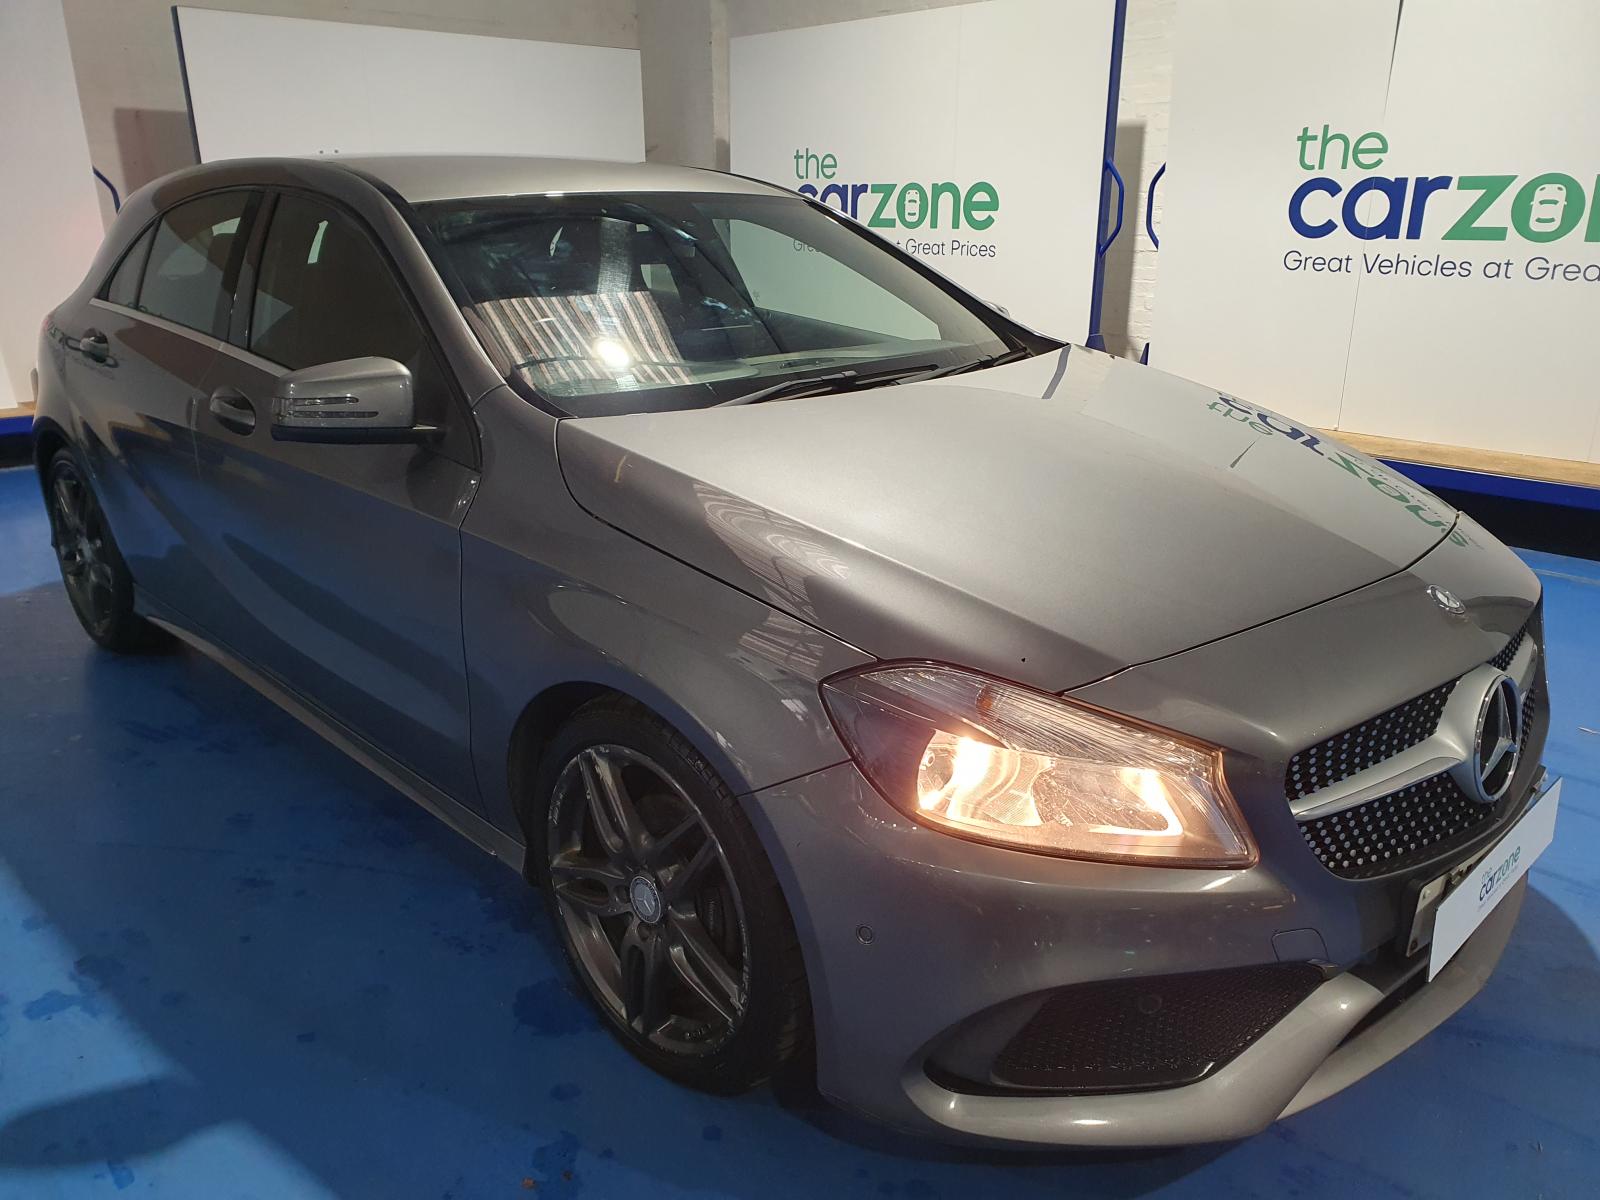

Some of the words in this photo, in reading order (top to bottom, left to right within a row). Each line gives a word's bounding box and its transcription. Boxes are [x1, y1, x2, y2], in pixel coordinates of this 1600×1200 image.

[793, 148, 838, 179] the
[1296, 124, 1389, 171] the
[1288, 172, 1600, 243] carzo
[905, 238, 945, 256] Great
[950, 239, 997, 258] Prices
[1283, 250, 1353, 274] Great
[1362, 252, 1472, 278] Vehicles
[1483, 258, 1514, 279] at
[1479, 845, 1521, 902] carzone
